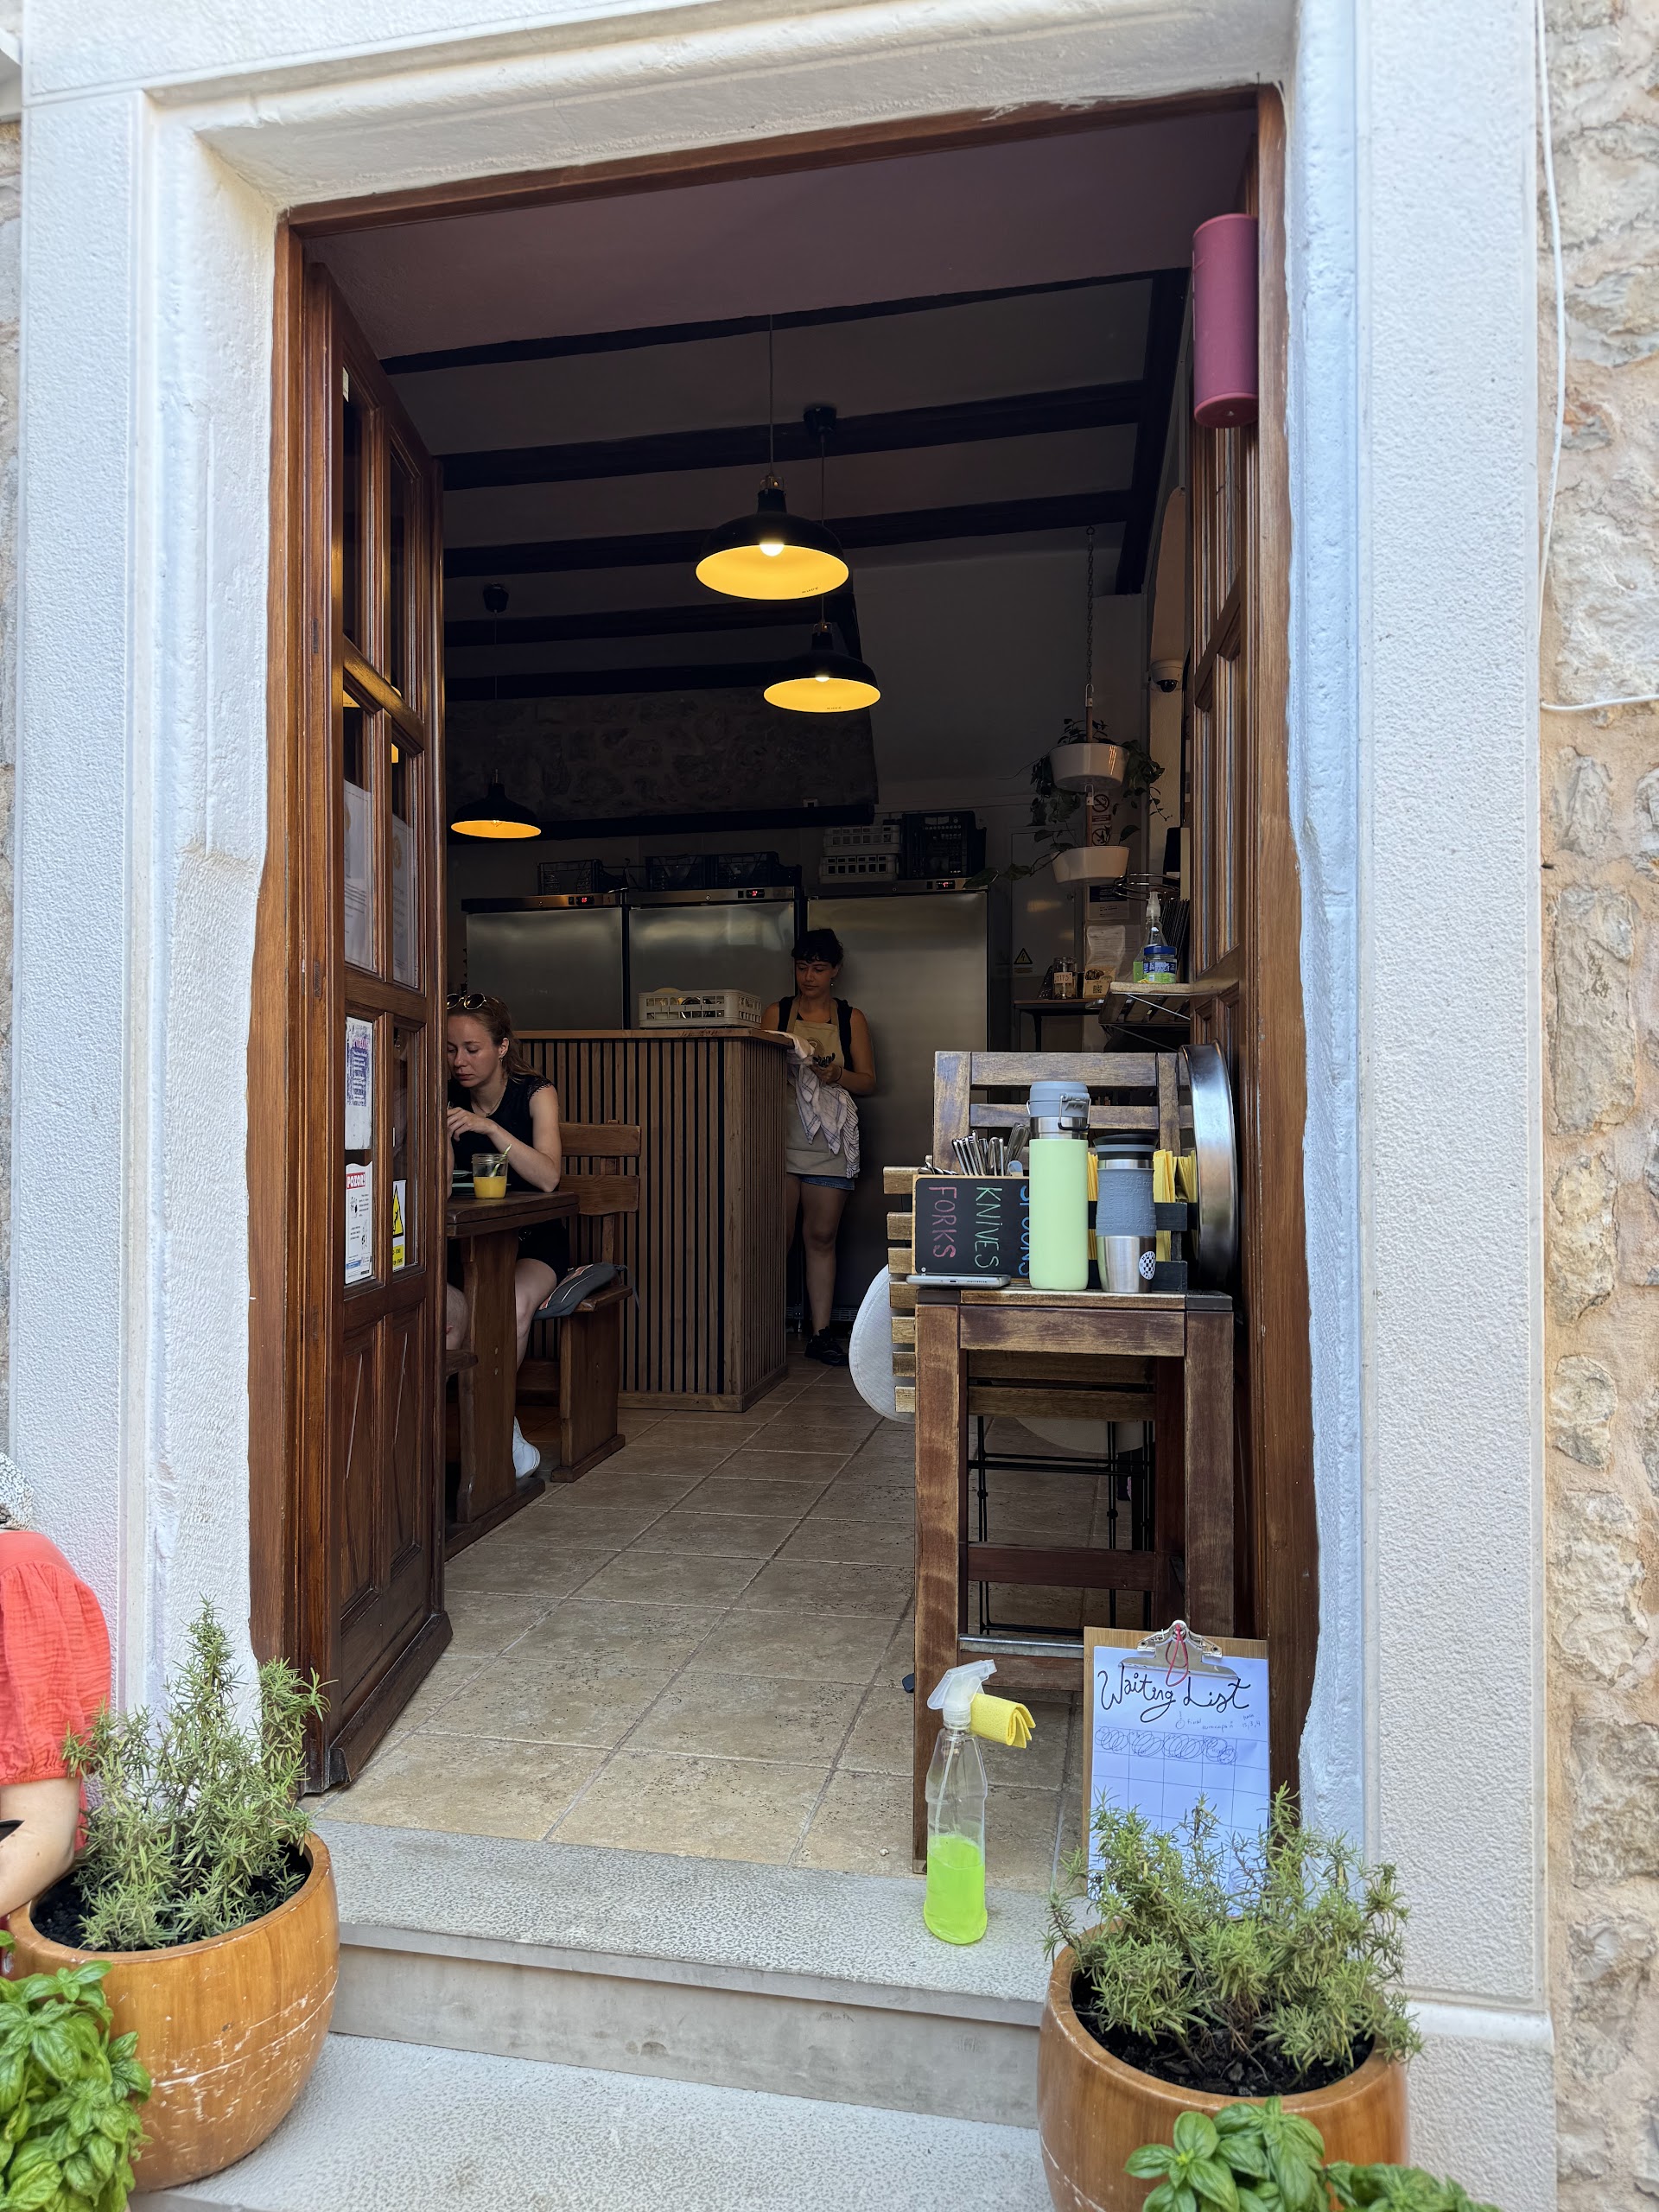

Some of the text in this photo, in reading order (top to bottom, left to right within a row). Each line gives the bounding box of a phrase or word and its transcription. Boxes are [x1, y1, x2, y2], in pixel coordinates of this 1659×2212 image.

[929, 1186, 957, 1258] FORKS
[1097, 1663, 1251, 1723] Waiting List
